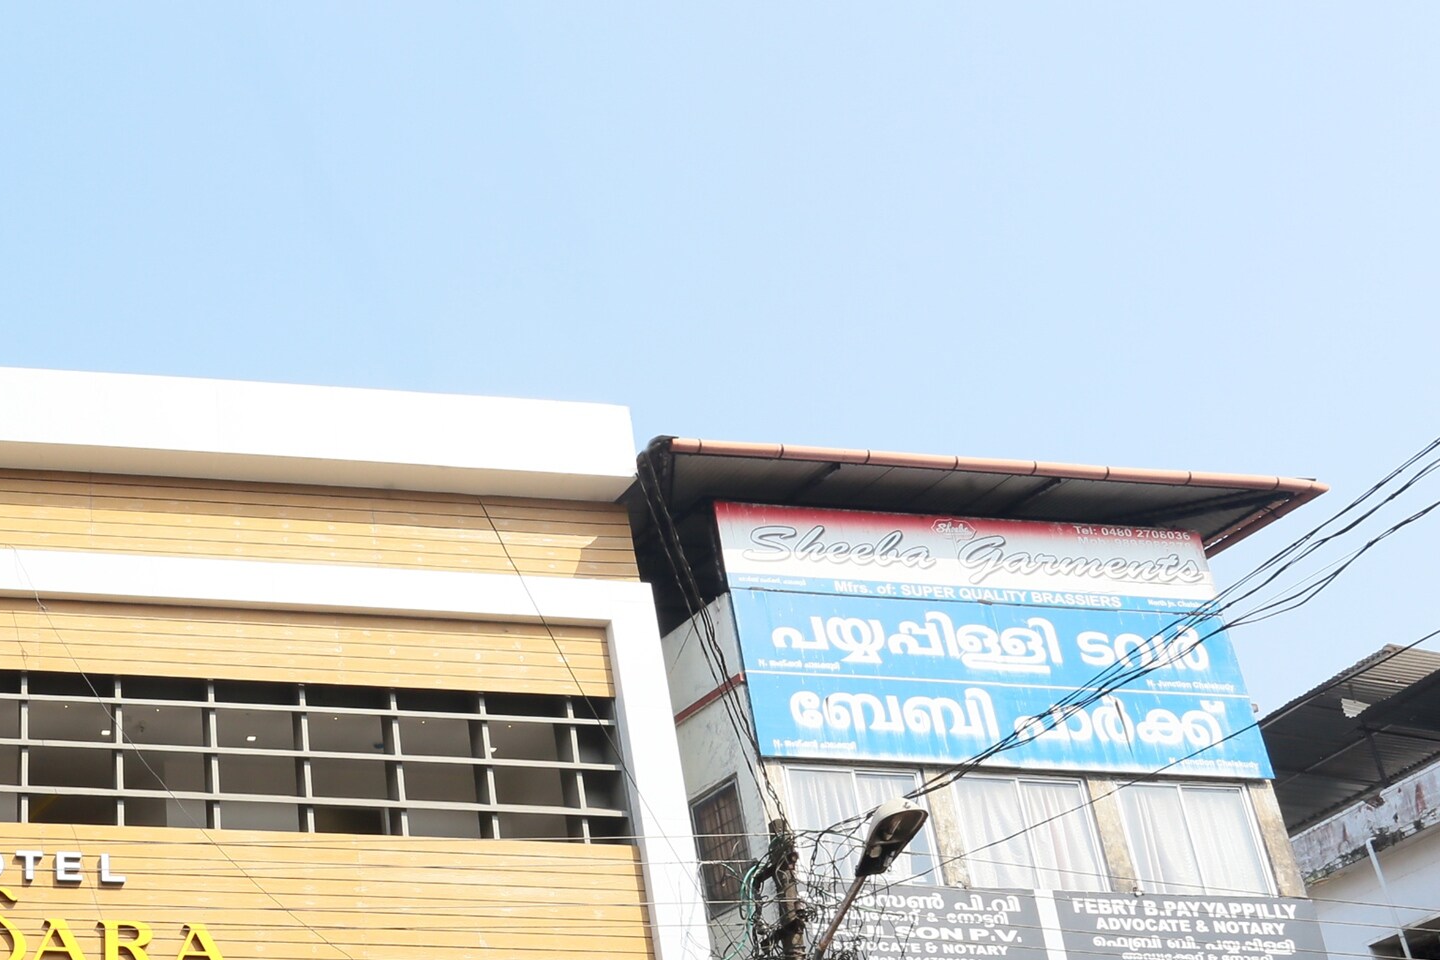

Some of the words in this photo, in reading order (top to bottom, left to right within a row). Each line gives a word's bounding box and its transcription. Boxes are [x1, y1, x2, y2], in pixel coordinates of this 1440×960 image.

[1073, 525, 1098, 536] Tel:
[743, 525, 936, 569] Sheeba
[958, 535, 1204, 584] Garments
[834, 580, 869, 594] Mfrs.
[876, 583, 897, 596] of:
[901, 585, 955, 599] SUPER
[959, 588, 1028, 604] QUALITY
[1031, 593, 1122, 608] BRASSIERS
[790, 688, 1000, 740] ബേബി
[1072, 897, 1138, 915] FEBRY
[926, 912, 939, 922] &
[969, 928, 1023, 943] P.V.
[1096, 917, 1192, 933] ADVOCATE
[1195, 920, 1209, 933] &
[1214, 921, 1286, 936] NOTARY
[925, 942, 938, 954] &
[942, 944, 1008, 956] NOTARY
